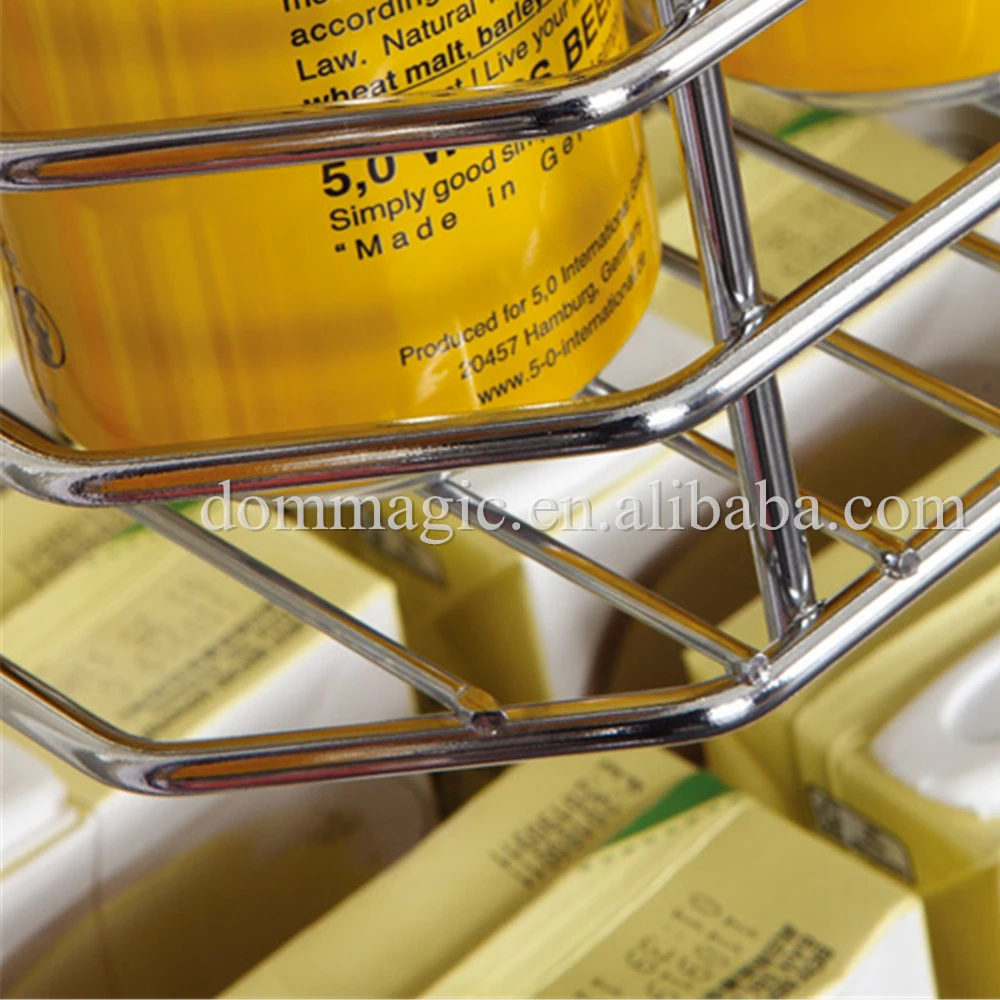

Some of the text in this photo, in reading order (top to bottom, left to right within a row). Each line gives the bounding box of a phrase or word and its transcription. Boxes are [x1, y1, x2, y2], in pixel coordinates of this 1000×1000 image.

[295, 49, 368, 83] Law.
[404, 40, 474, 86] malt,
[484, 39, 529, 83] Live
[329, 185, 427, 232] Simply
[432, 150, 497, 202] good
[486, 178, 516, 209] in
[399, 311, 499, 366] Produced
[502, 297, 527, 324] for
[530, 275, 559, 305] 5,0
[458, 335, 518, 381] 20457
